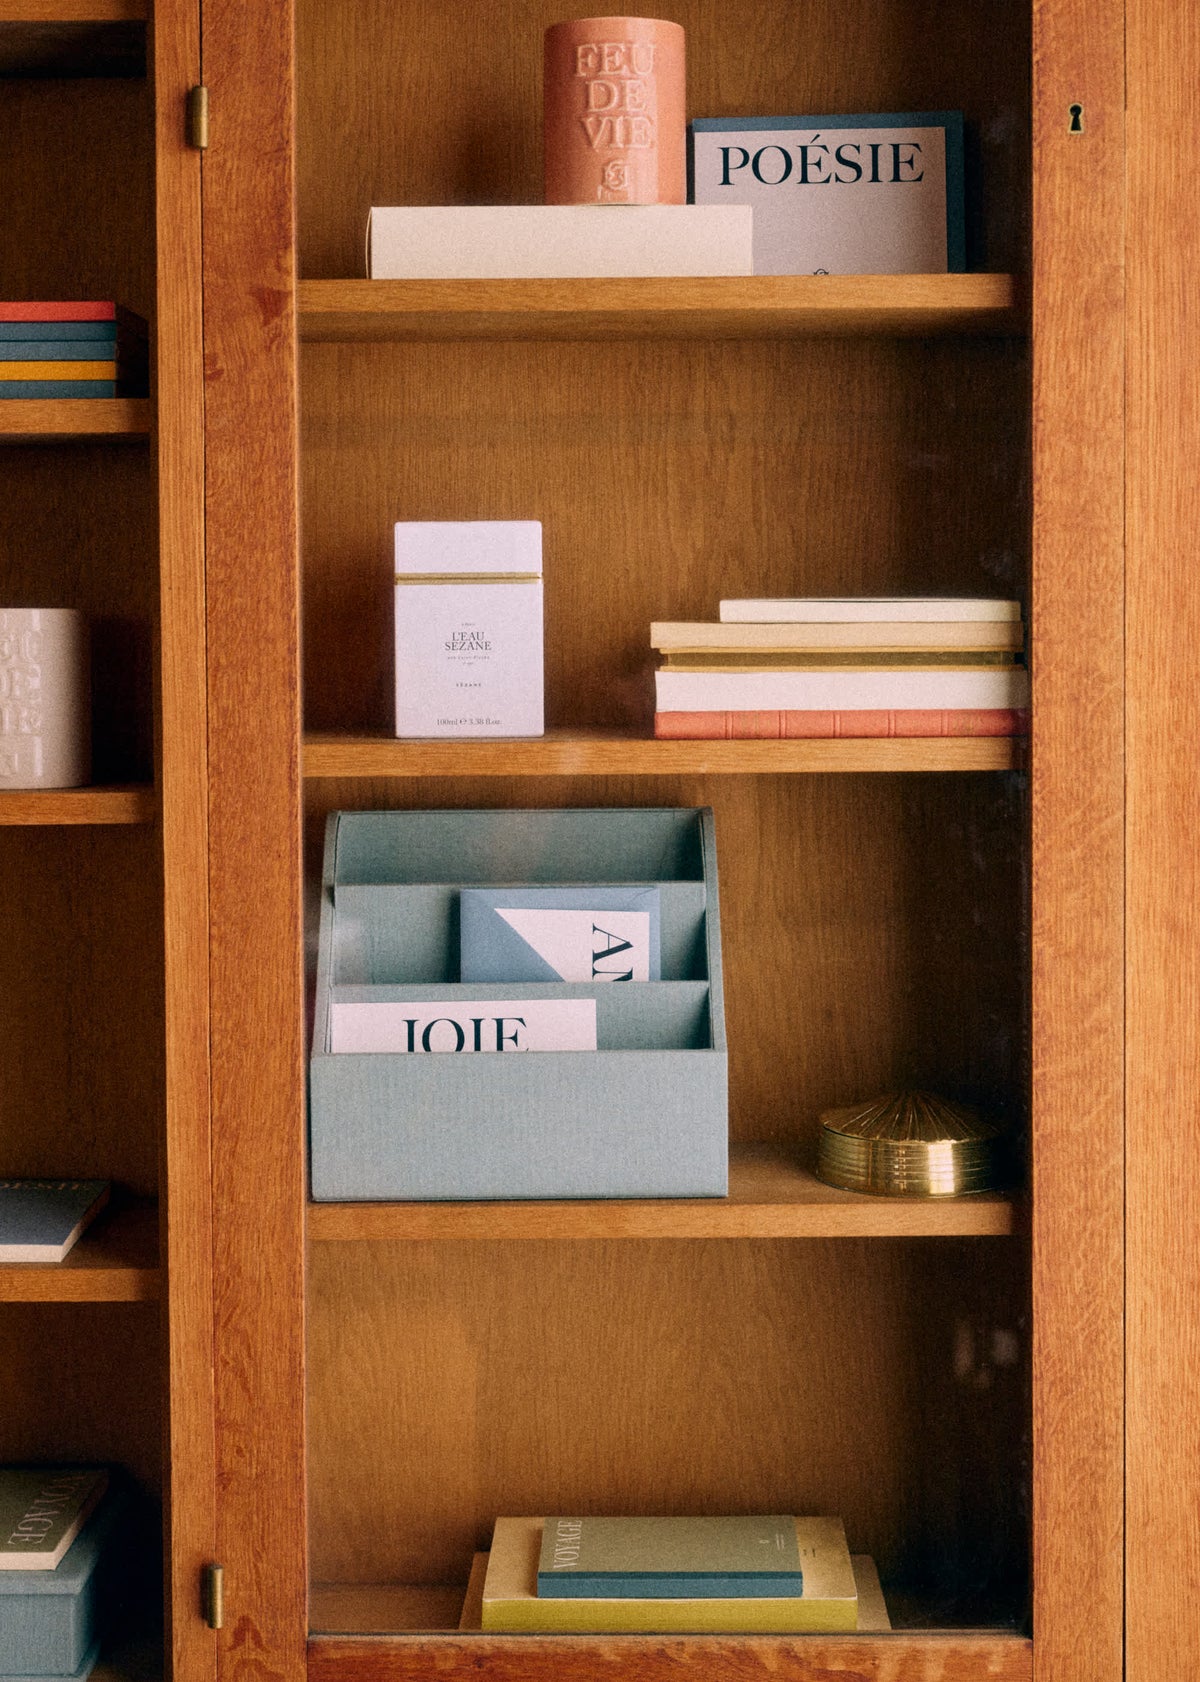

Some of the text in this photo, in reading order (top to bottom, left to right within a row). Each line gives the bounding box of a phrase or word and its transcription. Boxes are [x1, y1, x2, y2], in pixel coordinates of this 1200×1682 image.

[575, 42, 657, 78] FEU
[587, 79, 649, 113] DE
[580, 115, 655, 153] VIE
[717, 134, 925, 186] POÉSIE
[444, 641, 492, 651] SEZANE
[452, 631, 485, 641] L'EAU
[553, 1520, 583, 1570] VOYAGE
